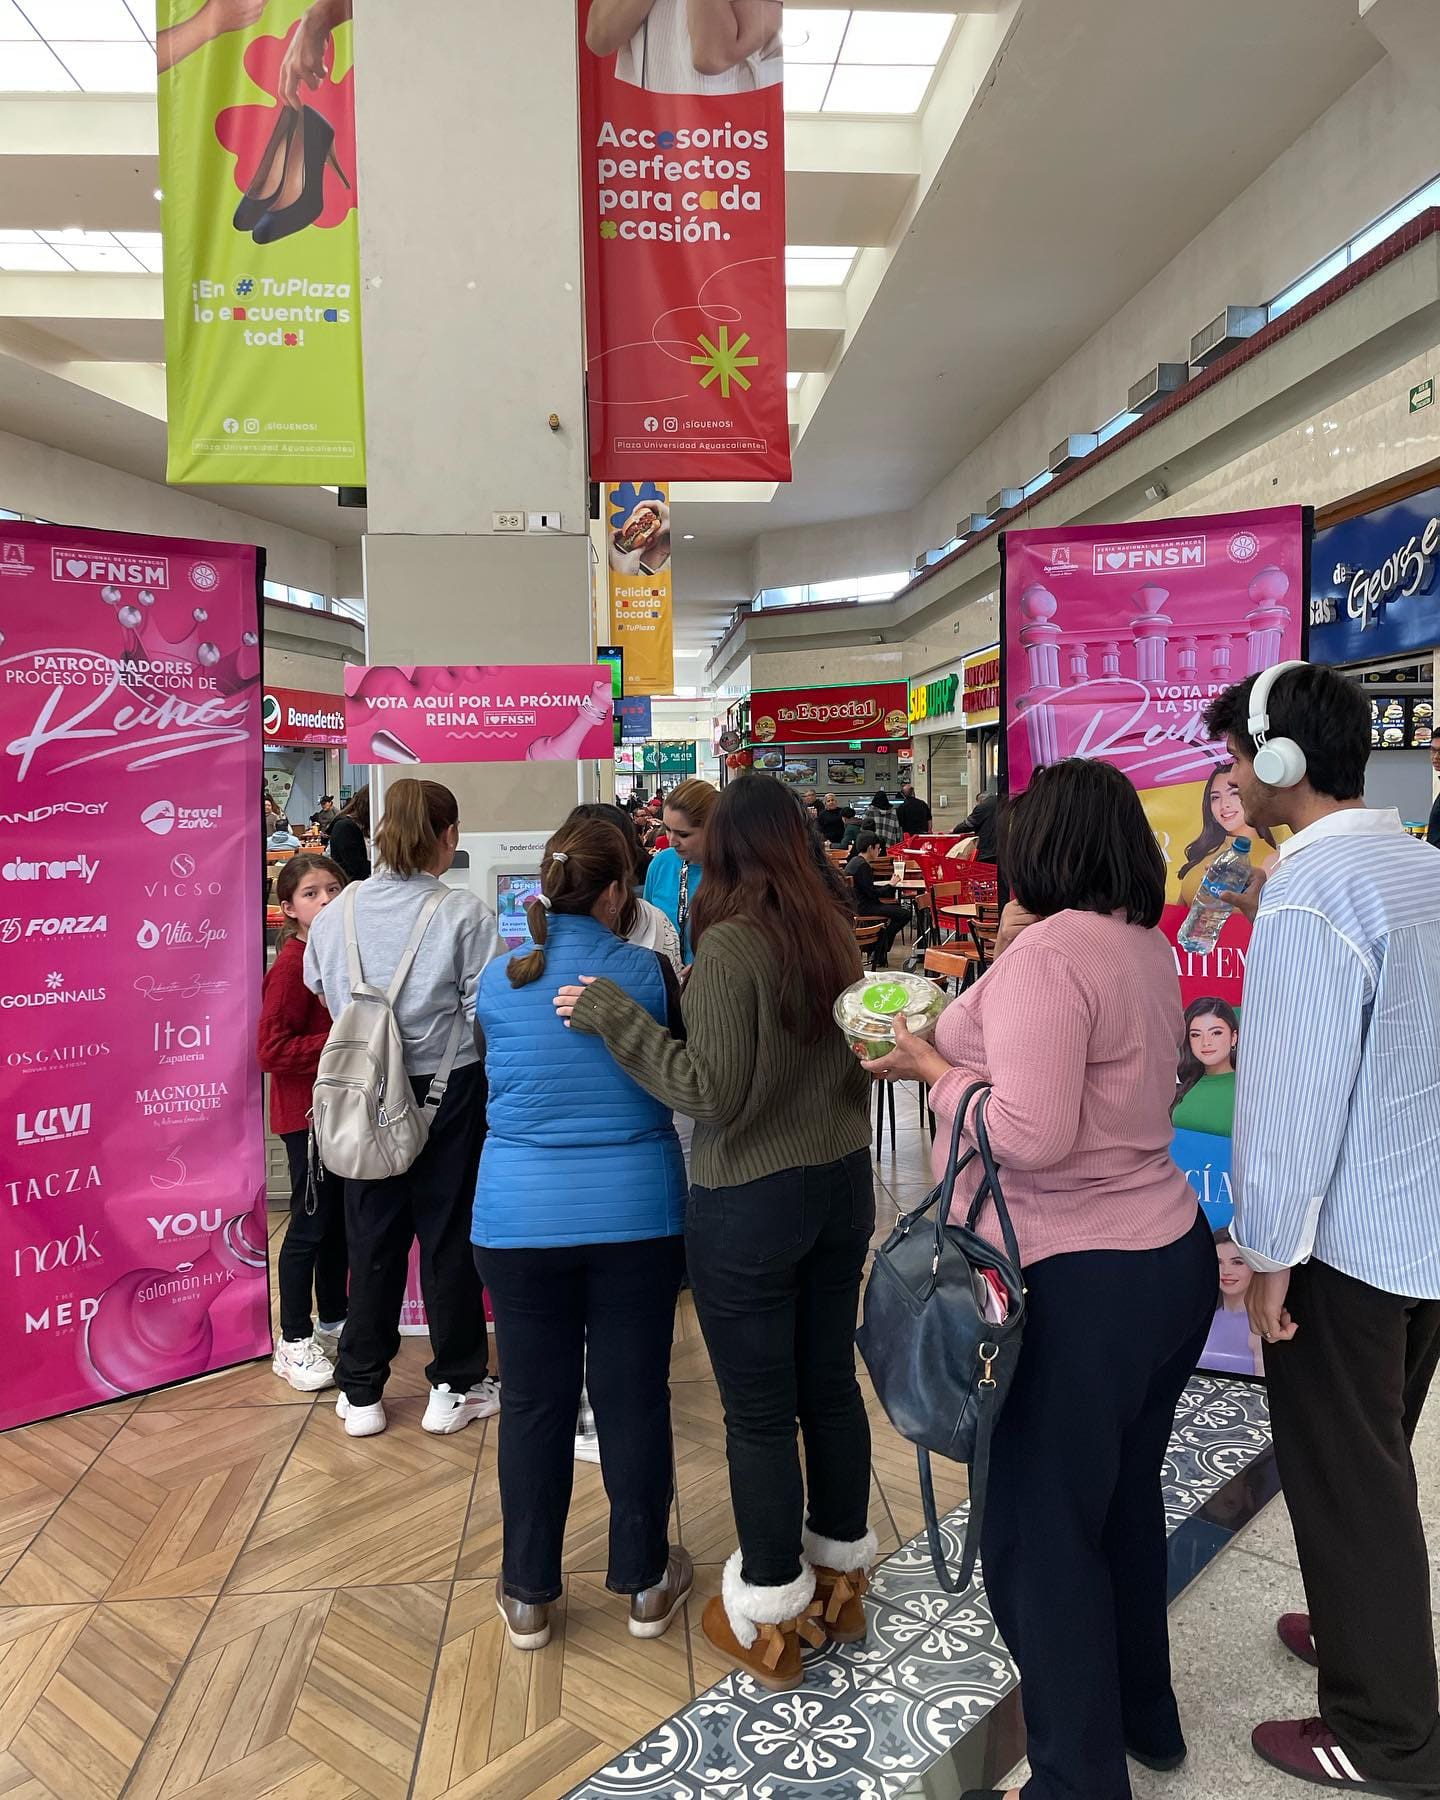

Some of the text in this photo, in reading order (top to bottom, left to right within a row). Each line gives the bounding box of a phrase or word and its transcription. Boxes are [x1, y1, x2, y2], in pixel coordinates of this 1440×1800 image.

[597, 122, 768, 149] Accesorios
[598, 155, 751, 184] perfectos
[600, 184, 760, 214] para cada
[192, 280, 225, 301] ¡En
[261, 278, 350, 298] TuPlaza
[194, 304, 350, 323] lo encuentras
[617, 441, 765, 450] Plaza Universidad Aguascalientes
[1128, 546, 1202, 569] FNSM
[90, 561, 165, 585] FNSM
[1347, 518, 1440, 632] George
[615, 587, 666, 597] Felicidad
[632, 599, 661, 608] cada
[34, 656, 193, 675] PATROCINADORES
[6, 669, 86, 685] PROCESO
[93, 672, 113, 686] DE
[199, 677, 217, 690] DE
[365, 692, 592, 710] VOTA AQUÍ POR LA PRÓXIMA
[910, 675, 956, 723] SUBWAY
[1156, 685, 1202, 699] VOTA
[778, 708, 793, 721] La
[797, 699, 875, 722] Especial
[1156, 700, 1177, 713] LA
[288, 707, 345, 730] Benedetti's
[426, 713, 479, 727] REINA
[500, 714, 534, 724] FNSM
[178, 804, 222, 818] travel
[178, 817, 215, 829] zone
[25, 915, 107, 936] FORZA
[196, 918, 228, 949] Spa
[0, 987, 106, 1009] GOLDENNAILS
[154, 1015, 210, 1051] Itai
[136, 1081, 228, 1104] MAGNOLIA
[143, 1097, 221, 1116] BOUTIQUE
[5, 1165, 102, 1206] TACZA
[146, 1208, 222, 1240] YOU
[15, 1224, 102, 1277] nook
[25, 1298, 99, 1334] MED
